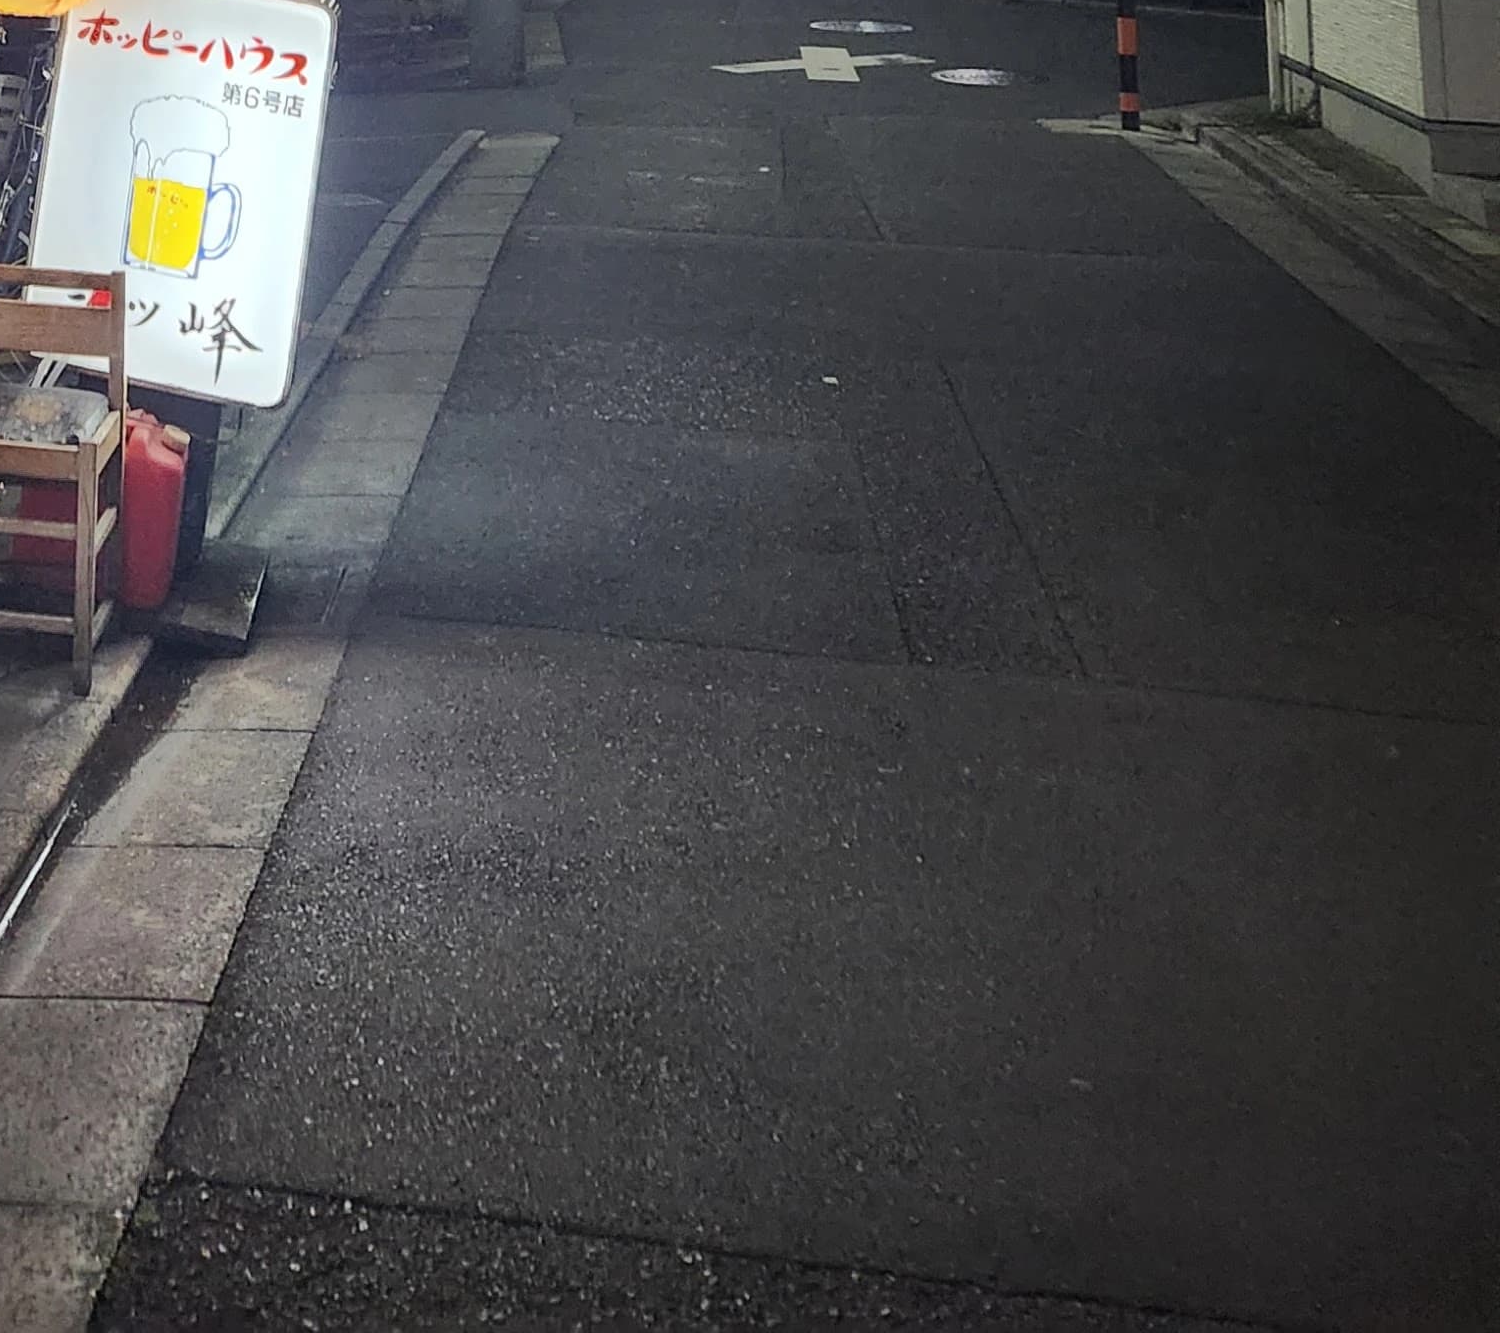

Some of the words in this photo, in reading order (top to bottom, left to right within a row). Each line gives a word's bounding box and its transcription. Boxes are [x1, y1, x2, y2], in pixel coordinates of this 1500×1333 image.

[77, 8, 308, 86] ホッピーハウス
[221, 81, 306, 119] 第6号店
[68, 293, 264, 387] ツ峰
